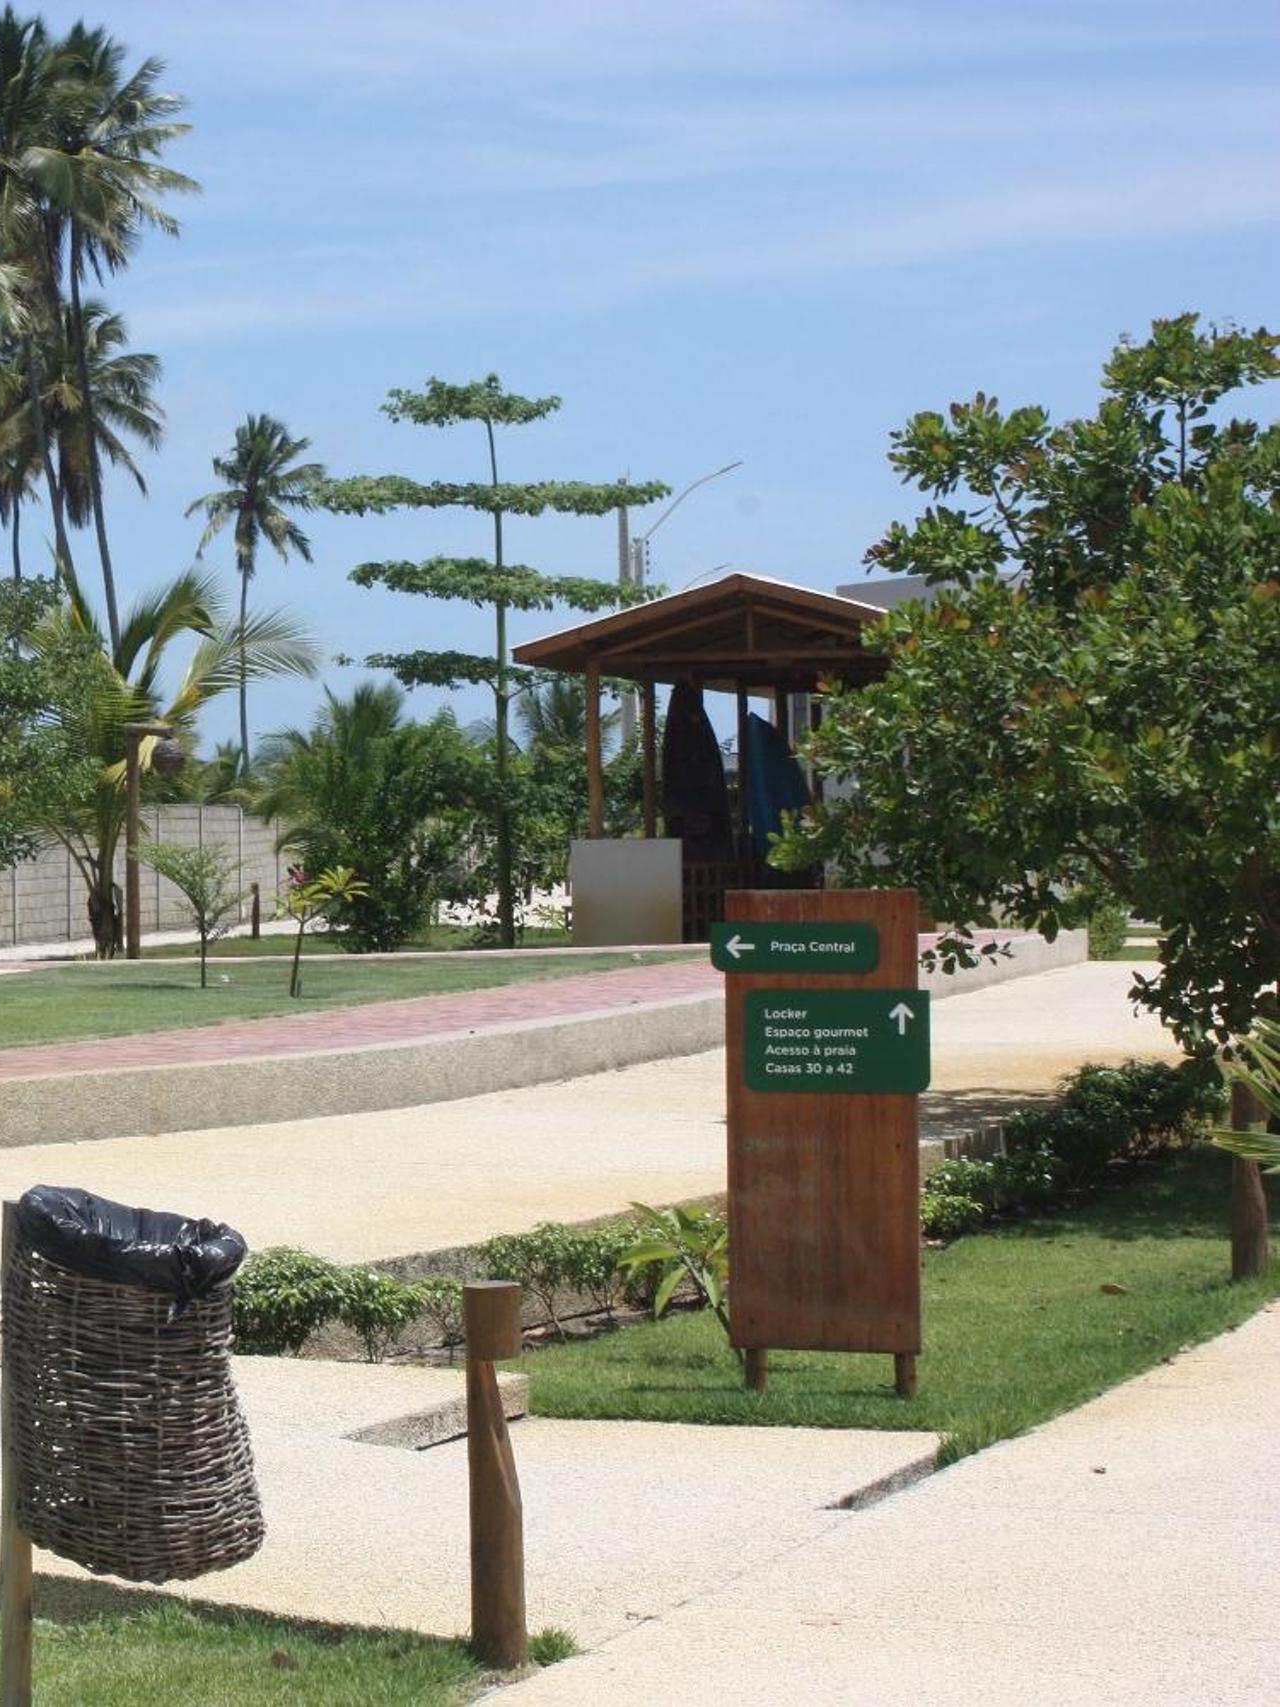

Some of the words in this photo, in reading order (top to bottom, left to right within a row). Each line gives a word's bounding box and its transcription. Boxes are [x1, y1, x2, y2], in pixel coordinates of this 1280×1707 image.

[770, 941, 806, 954] Praça
[809, 941, 855, 953] Central
[764, 1008, 808, 1019] Locker
[764, 1027, 810, 1039] Espaço
[813, 1027, 869, 1039] gourmet
[765, 1045, 809, 1056] Acesso
[813, 1045, 821, 1056] à
[824, 1045, 857, 1058] praia
[765, 1063, 802, 1074] Casas
[806, 1063, 822, 1074] 30
[825, 1065, 833, 1074] a
[836, 1063, 854, 1074] 42
